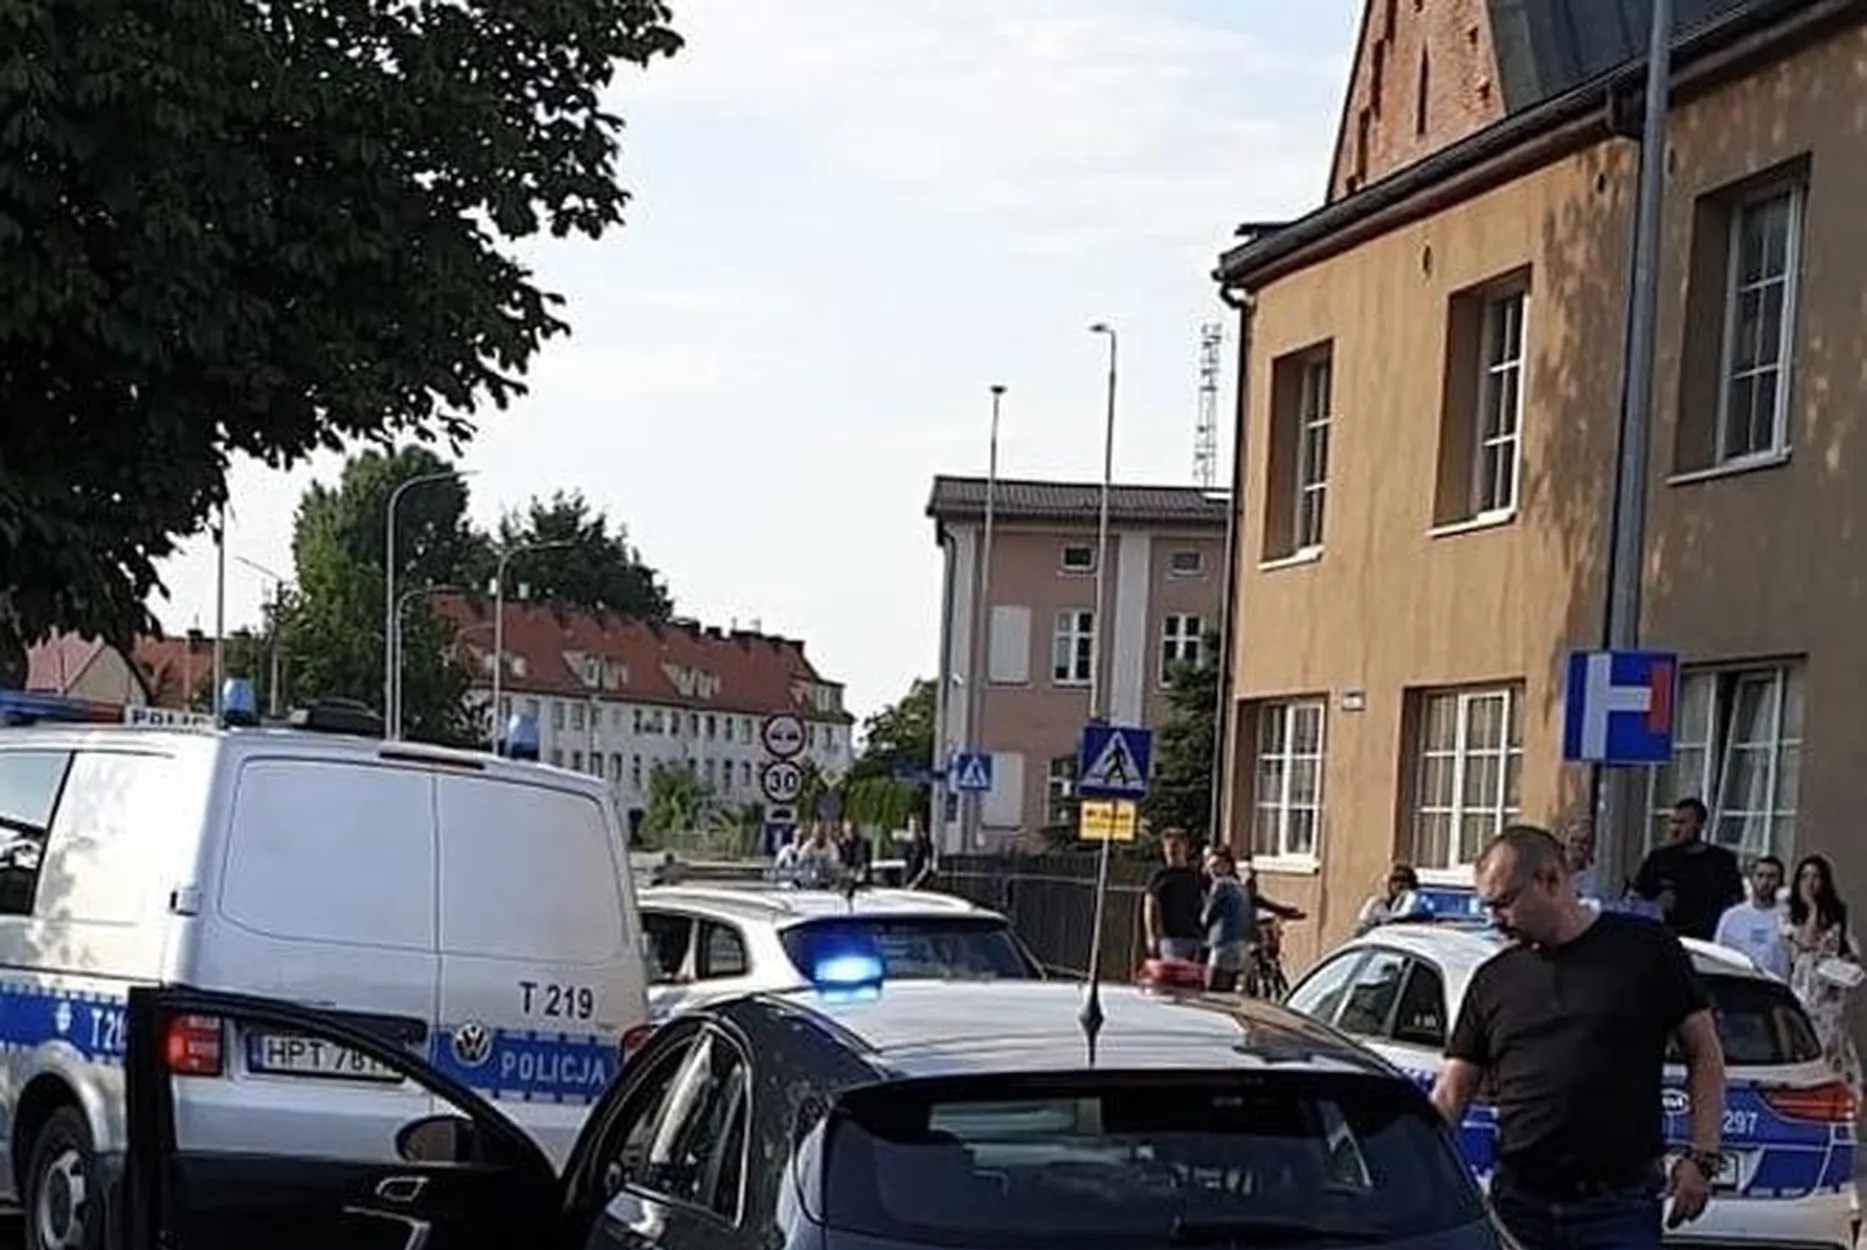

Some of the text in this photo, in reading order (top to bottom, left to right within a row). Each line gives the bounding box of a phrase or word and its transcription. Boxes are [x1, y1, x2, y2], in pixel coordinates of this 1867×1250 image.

[770, 771, 797, 792] 30
[519, 981, 594, 1020] T 219
[91, 1007, 126, 1052] T 21
[267, 1038, 322, 1068] HPT
[501, 1051, 606, 1086] POLICJA
[1722, 1109, 1758, 1134] 297
